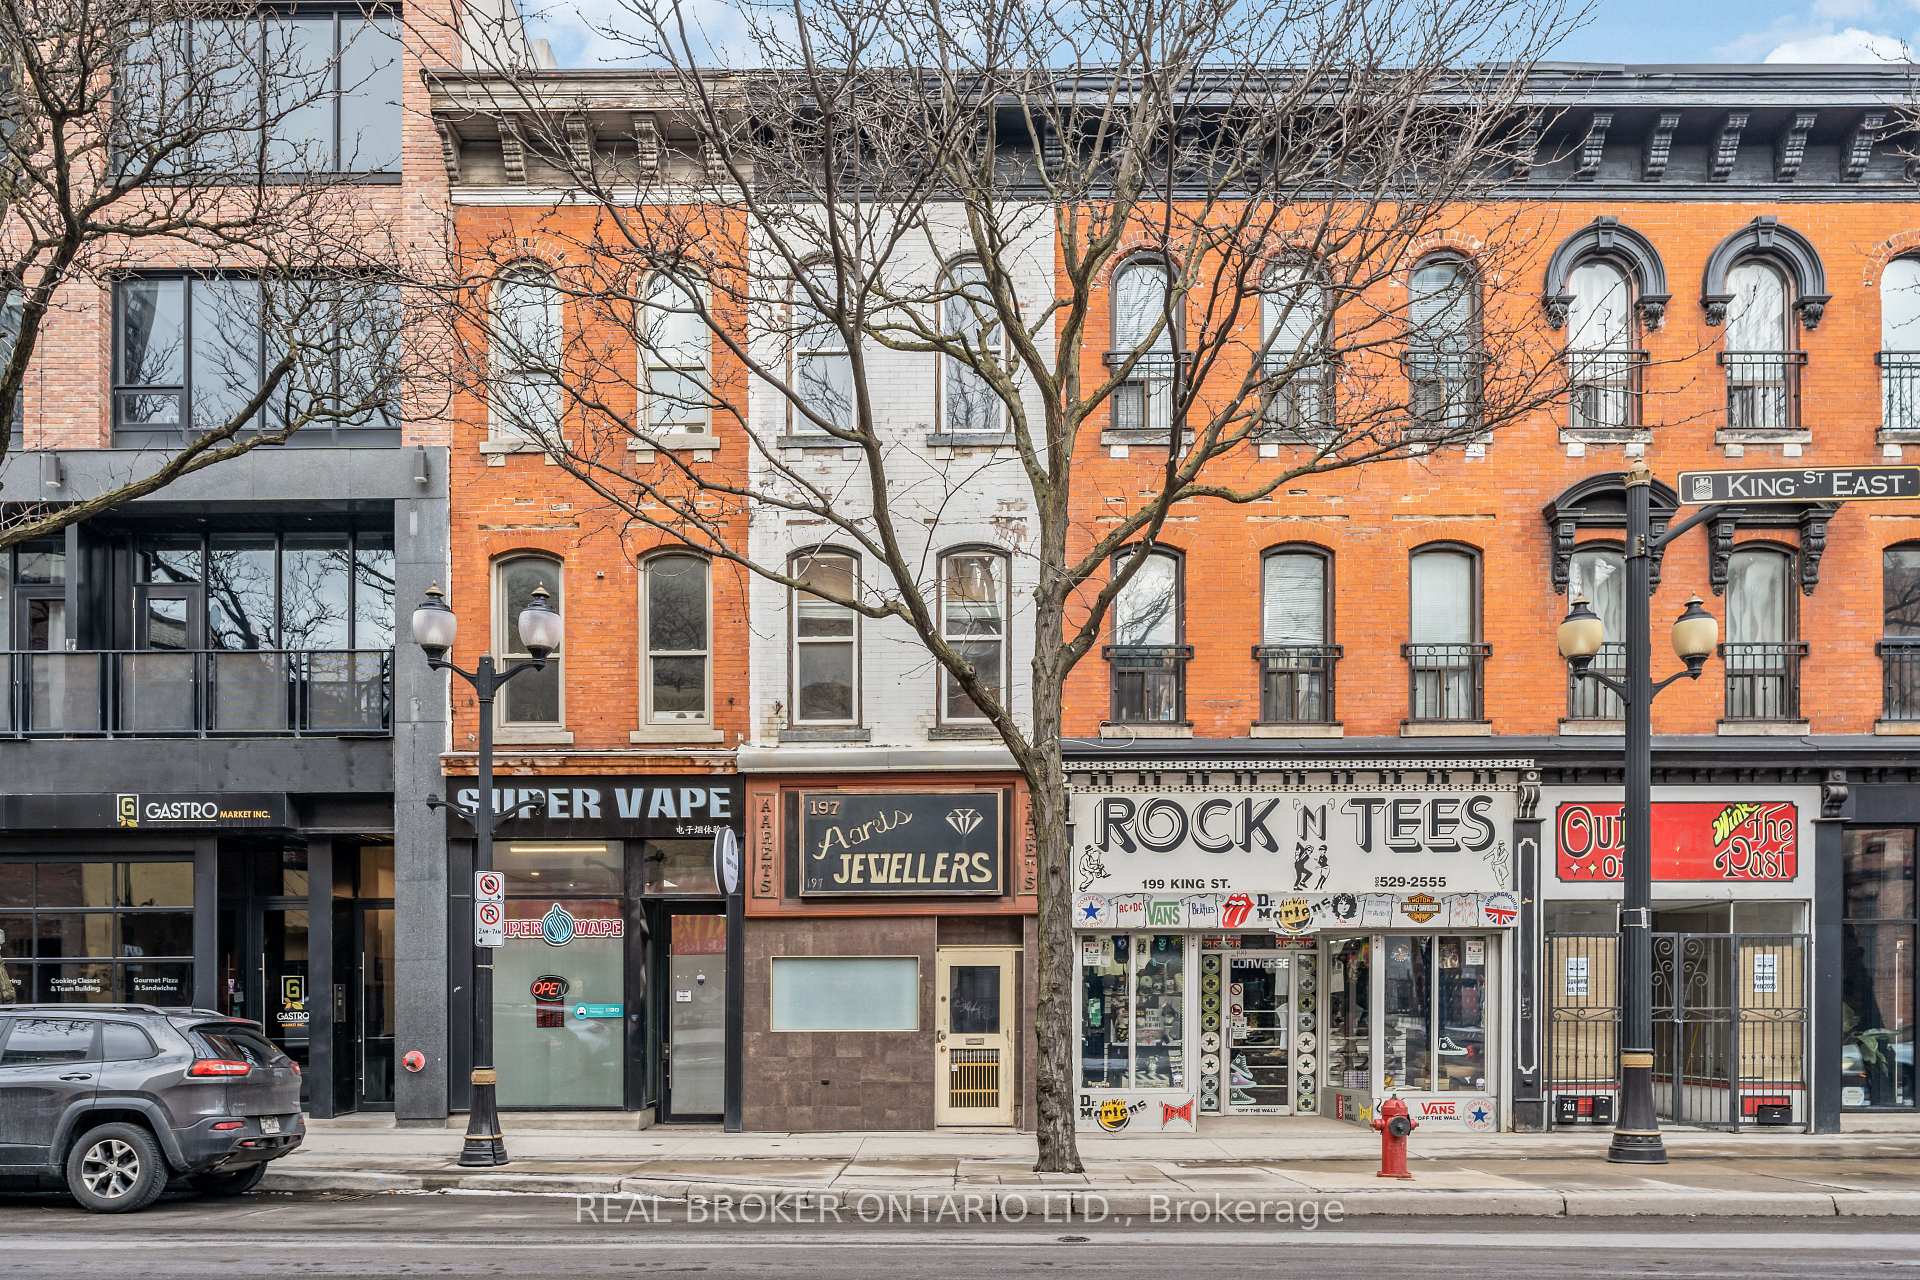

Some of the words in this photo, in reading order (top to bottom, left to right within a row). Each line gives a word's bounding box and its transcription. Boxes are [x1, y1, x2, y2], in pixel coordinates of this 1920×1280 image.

[1727, 475, 1795, 498] KING
[1803, 470, 1825, 484] ST
[1832, 471, 1904, 495] EAST
[145, 802, 218, 819] GASTRO
[219, 810, 251, 819] MARKET
[253, 810, 271, 819] INC.
[457, 787, 601, 818] SUPER
[614, 788, 731, 818] VAPE
[810, 800, 841, 816] 197
[1095, 797, 1279, 853] ROCK
[1341, 795, 1495, 853] TEES
[1715, 836, 1794, 878] Past
[833, 852, 993, 884] JEWELLERS
[1142, 879, 1164, 889] 199
[1170, 878, 1209, 889] KING
[1210, 878, 1231, 889] ST.
[1380, 876, 1447, 888] 529-2555
[1146, 901, 1180, 925] VANS
[1257, 898, 1331, 920] Martens
[504, 921, 542, 935] UPER
[575, 920, 622, 935] VAPE
[1231, 959, 1289, 969] CONVERSE
[533, 982, 567, 995] OPEN
[277, 1012, 309, 1020] GASTRO
[1080, 1100, 1147, 1118] Martens
[1421, 1102, 1456, 1115] VANS
[1563, 1103, 1576, 1111] 201
